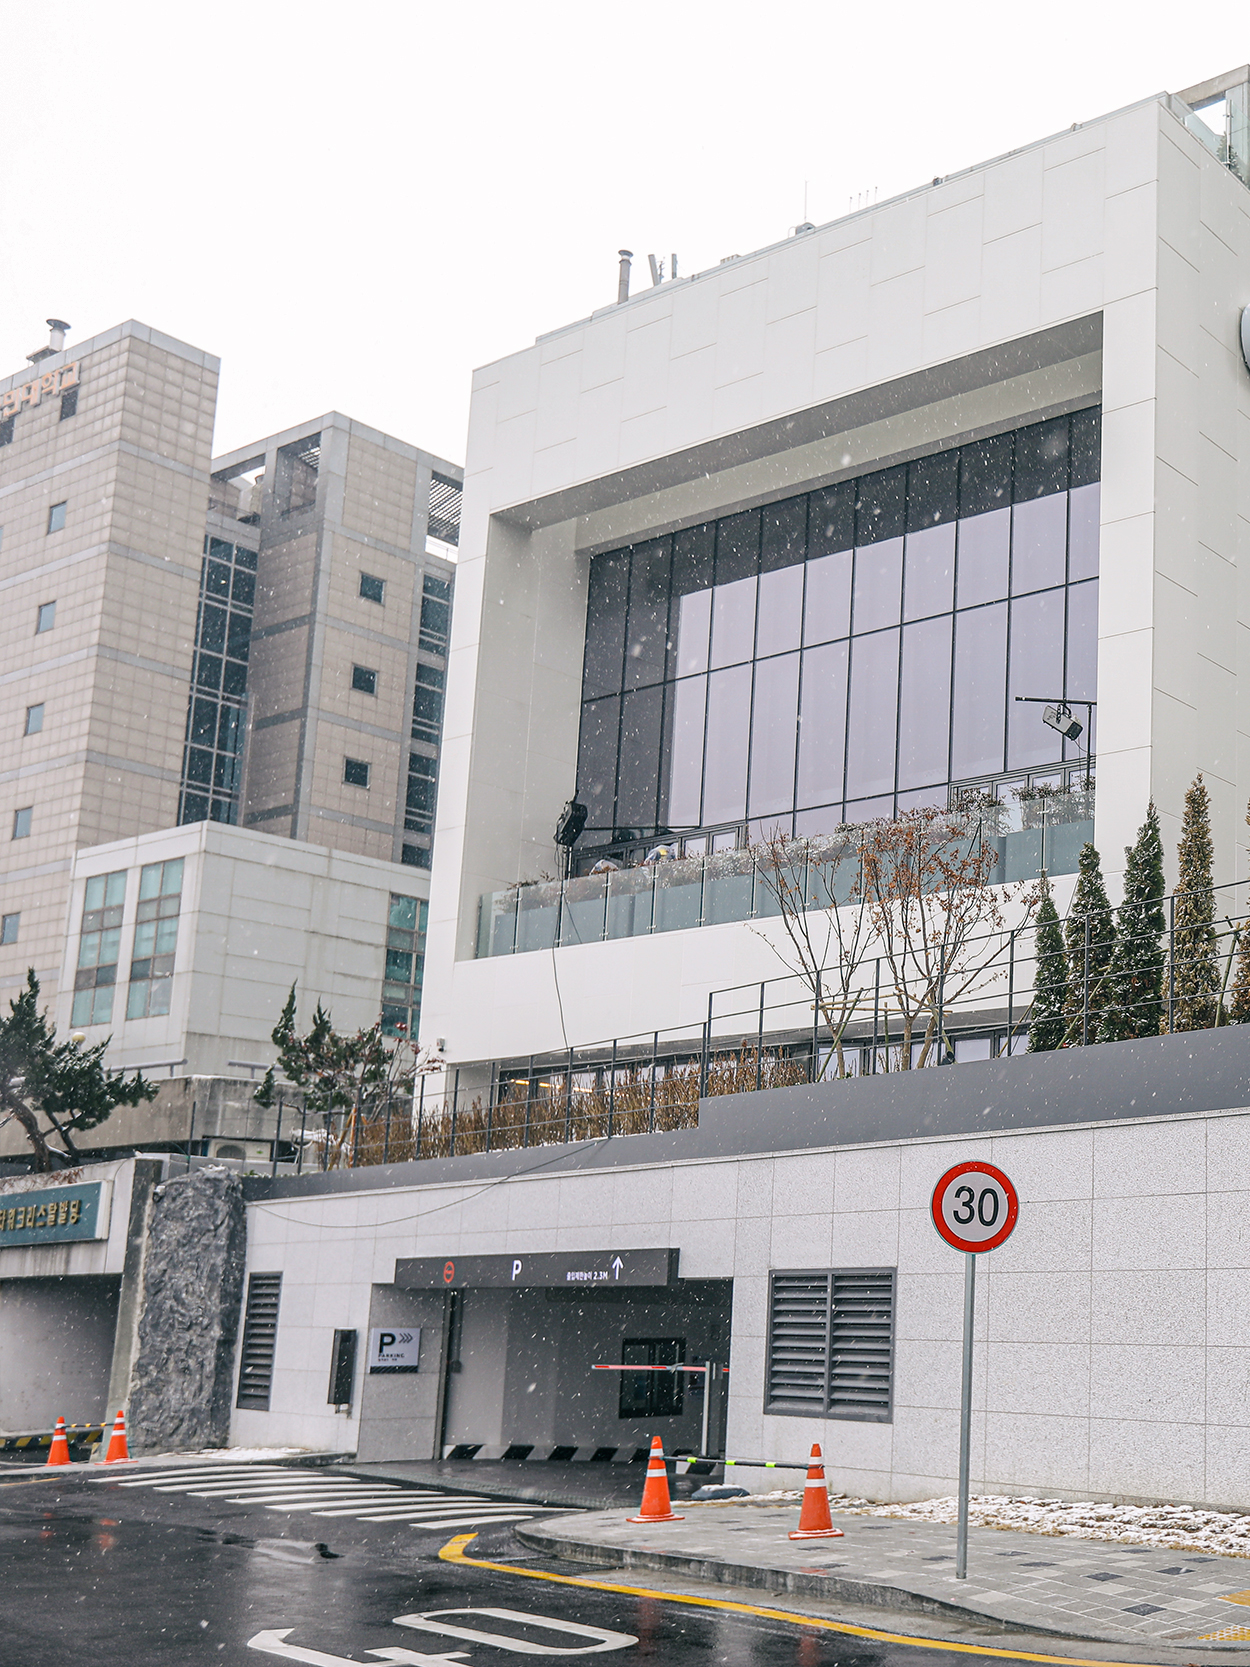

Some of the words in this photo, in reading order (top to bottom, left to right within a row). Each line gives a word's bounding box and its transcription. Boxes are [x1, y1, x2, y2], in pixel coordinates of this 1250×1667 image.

[0, 361, 80, 418] 민대학교
[953, 1186, 999, 1227] 30
[511, 1259, 523, 1281] P
[379, 1332, 396, 1353] P
